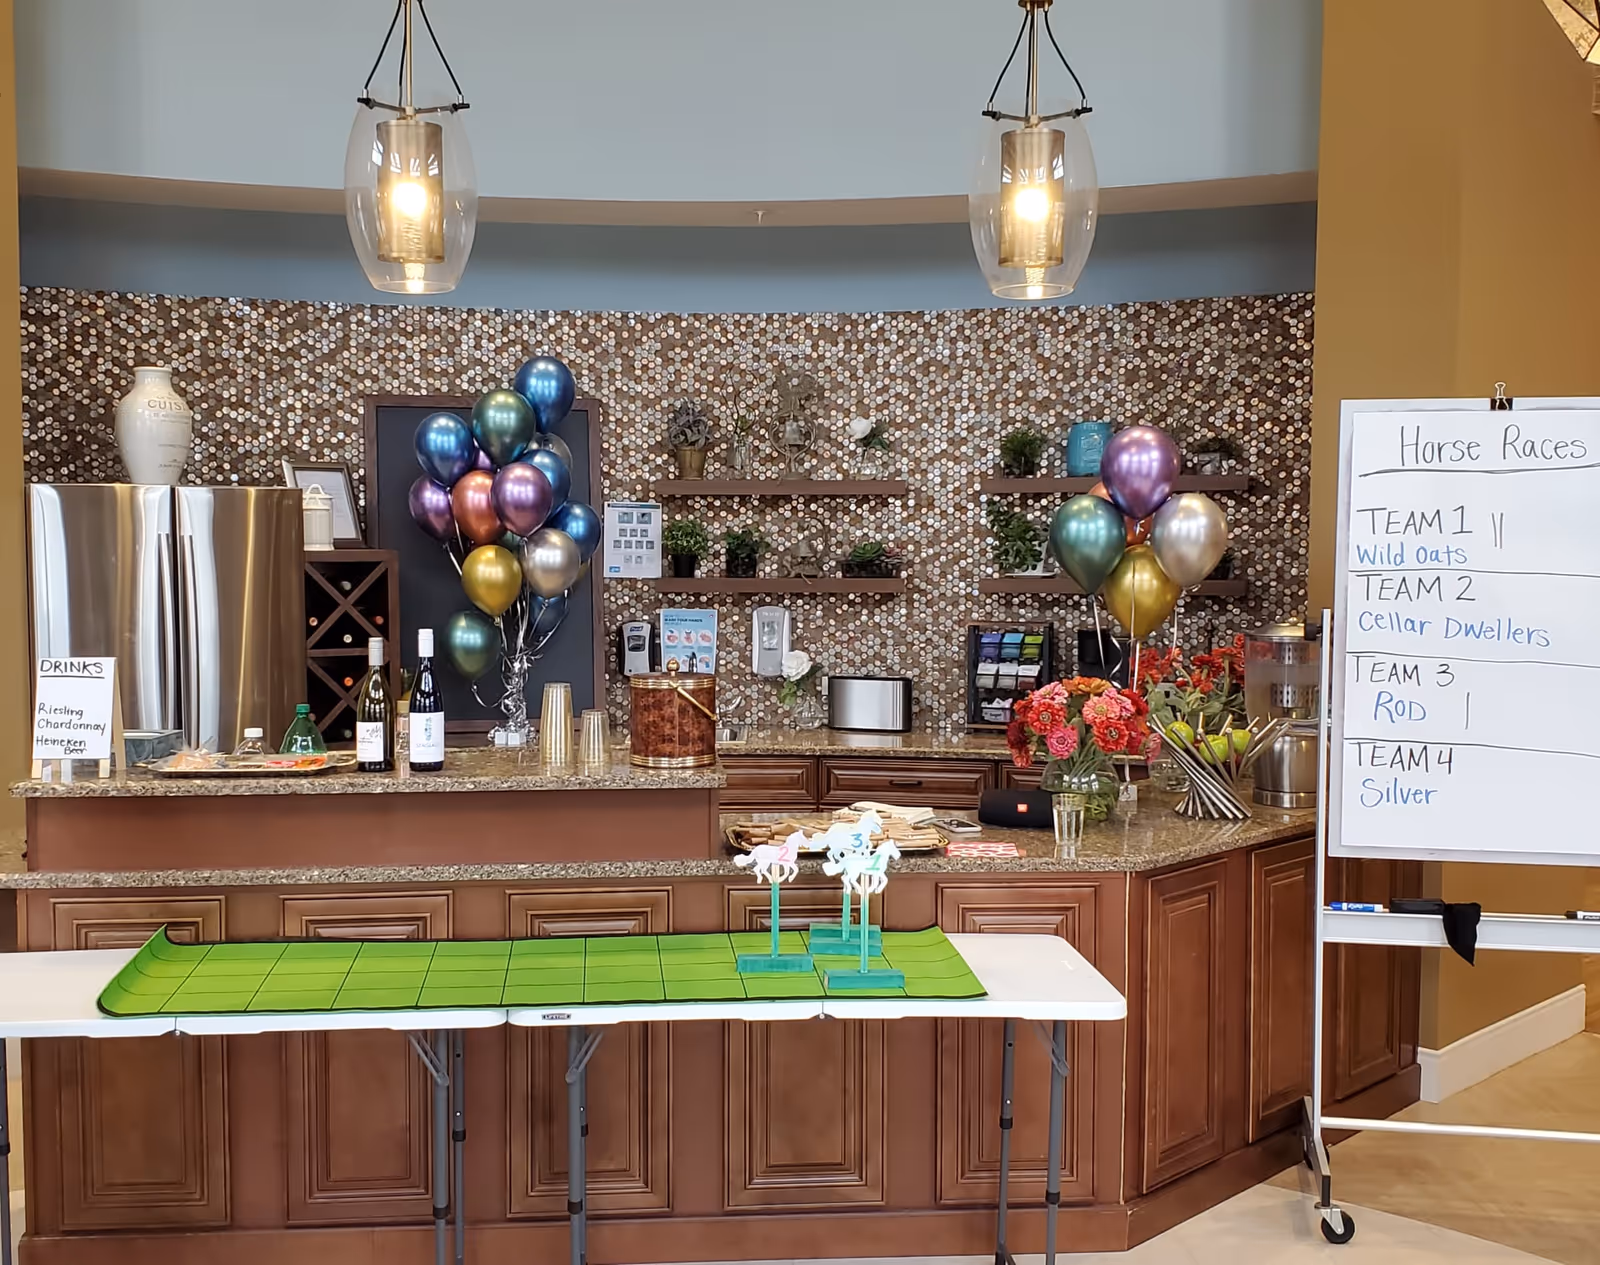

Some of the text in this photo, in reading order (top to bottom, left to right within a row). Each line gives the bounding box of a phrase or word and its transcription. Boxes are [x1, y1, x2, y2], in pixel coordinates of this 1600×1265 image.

[1400, 423, 1588, 466] Horse Races
[1356, 505, 1473, 535] TEAM 1
[1356, 542, 1405, 566] Wild
[1355, 573, 1477, 602] TEAM 2
[1444, 616, 1551, 648] Dwellers
[40, 659, 103, 675] DRINKS
[1351, 655, 1456, 688] TEAM 3
[38, 702, 84, 720] Riesling
[37, 718, 106, 736] Chardonnay
[36, 735, 87, 748] Heineken
[64, 747, 87, 755] Beer
[1347, 742, 1454, 775] TEAM 4
[1360, 777, 1439, 808] Silver
[850, 833, 863, 848] 3
[777, 846, 790, 862] 2
[865, 854, 881, 871] 1
